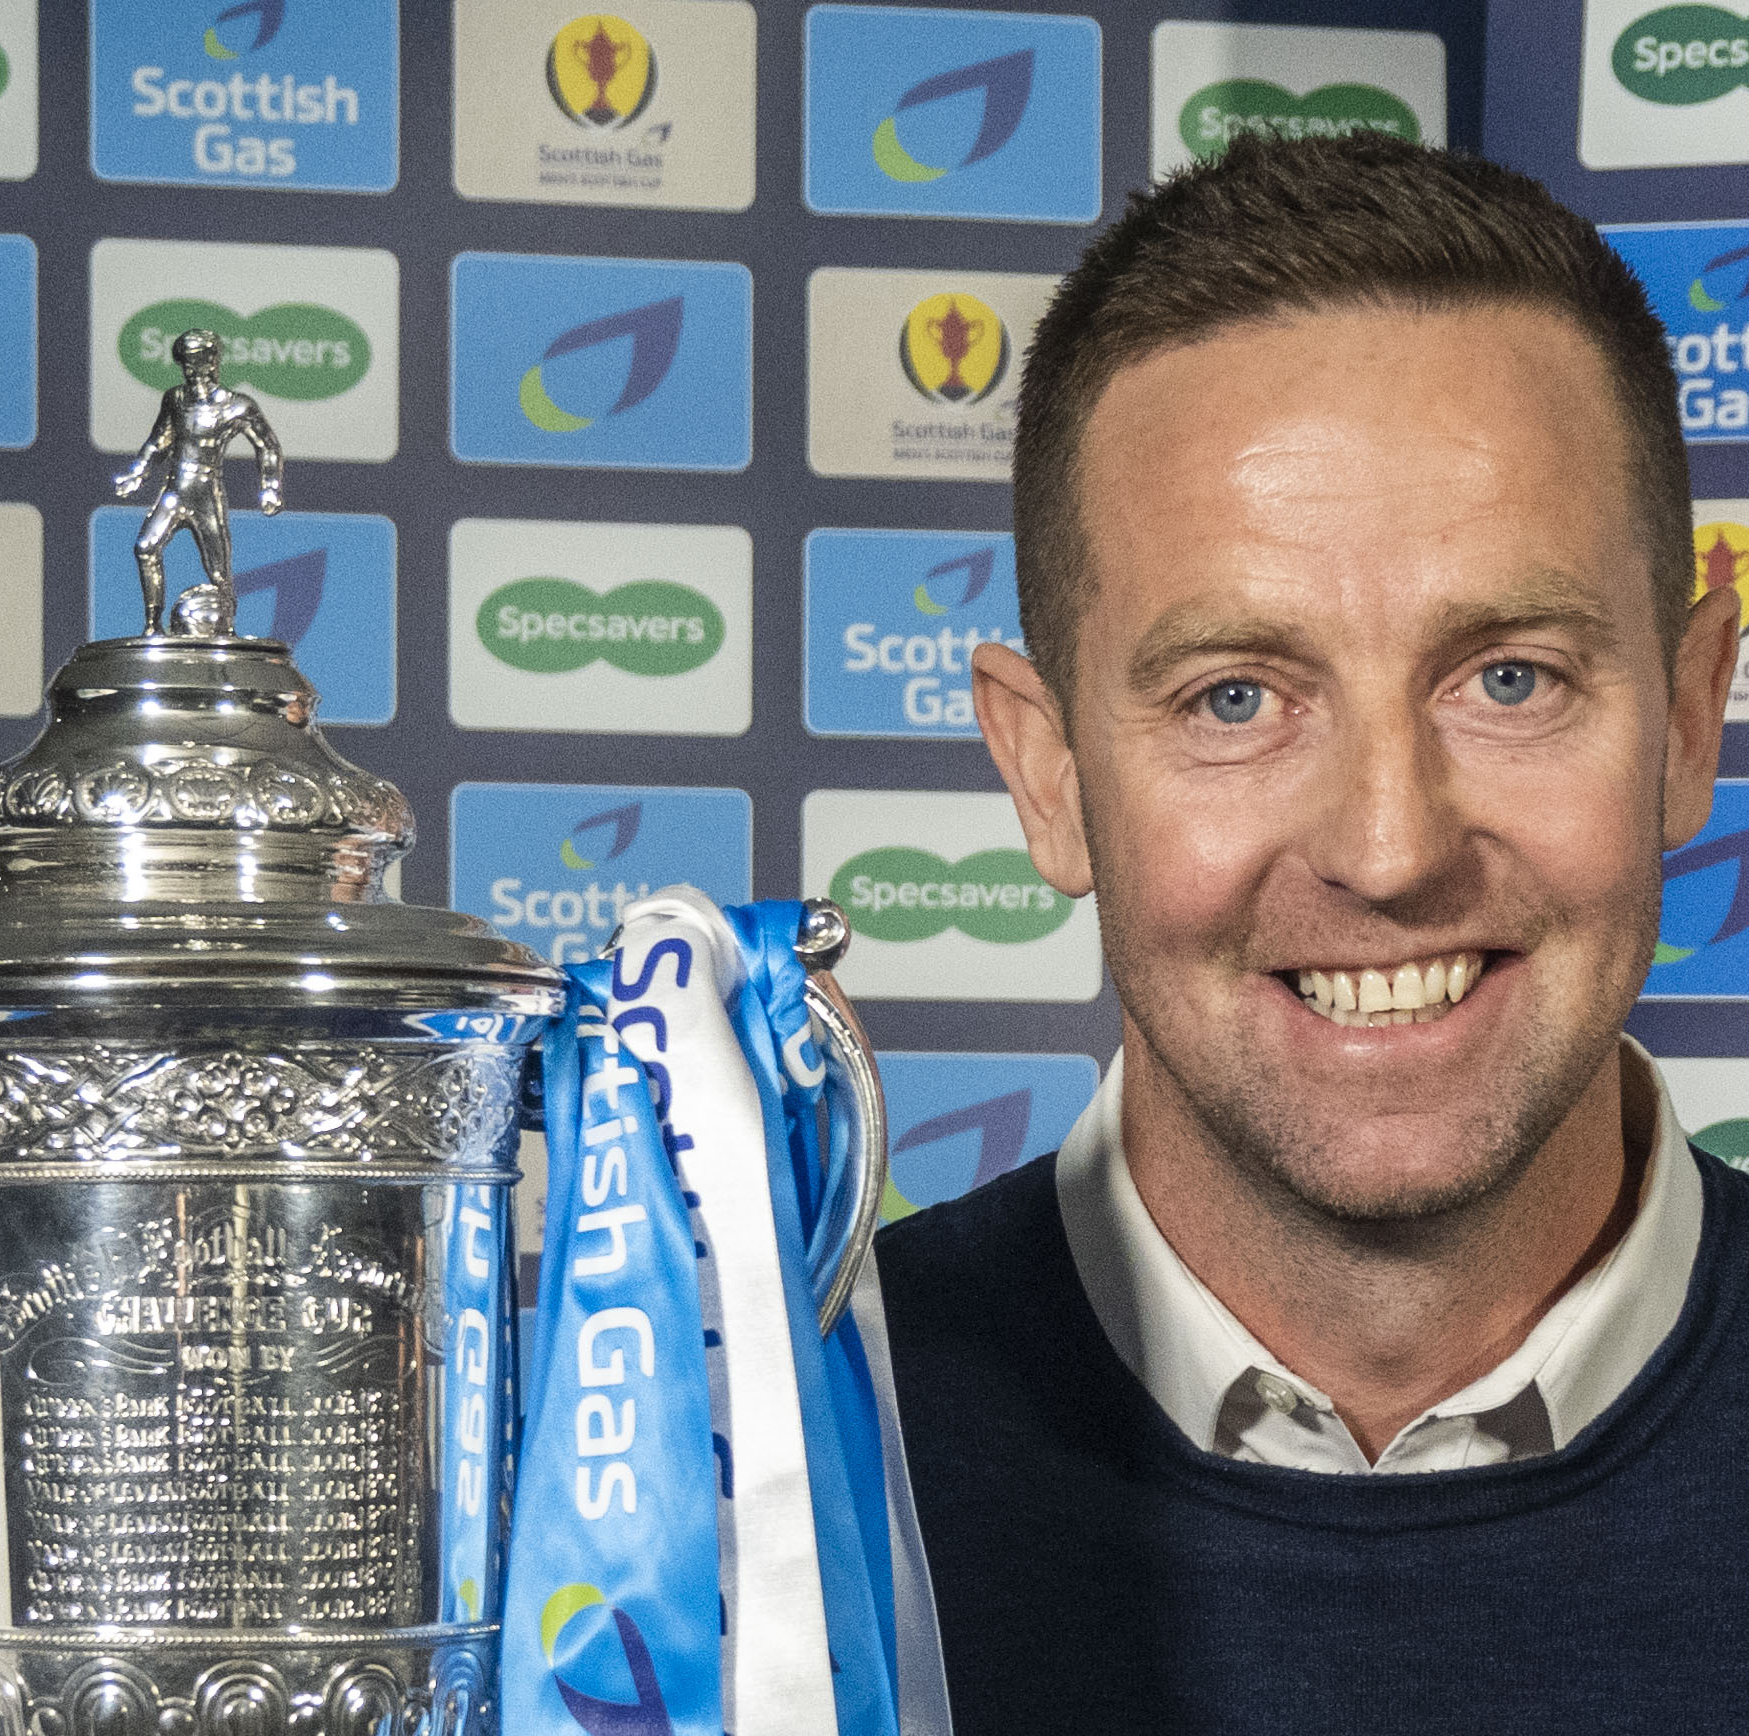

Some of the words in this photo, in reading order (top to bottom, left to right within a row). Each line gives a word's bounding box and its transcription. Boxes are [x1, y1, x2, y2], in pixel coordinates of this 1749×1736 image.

[133, 66, 361, 128] Scottish
[194, 123, 296, 176] Gas
[498, 605, 705, 643] Specsavers
[849, 872, 1056, 917] Specsavers
[575, 1309, 652, 1520] Gas
